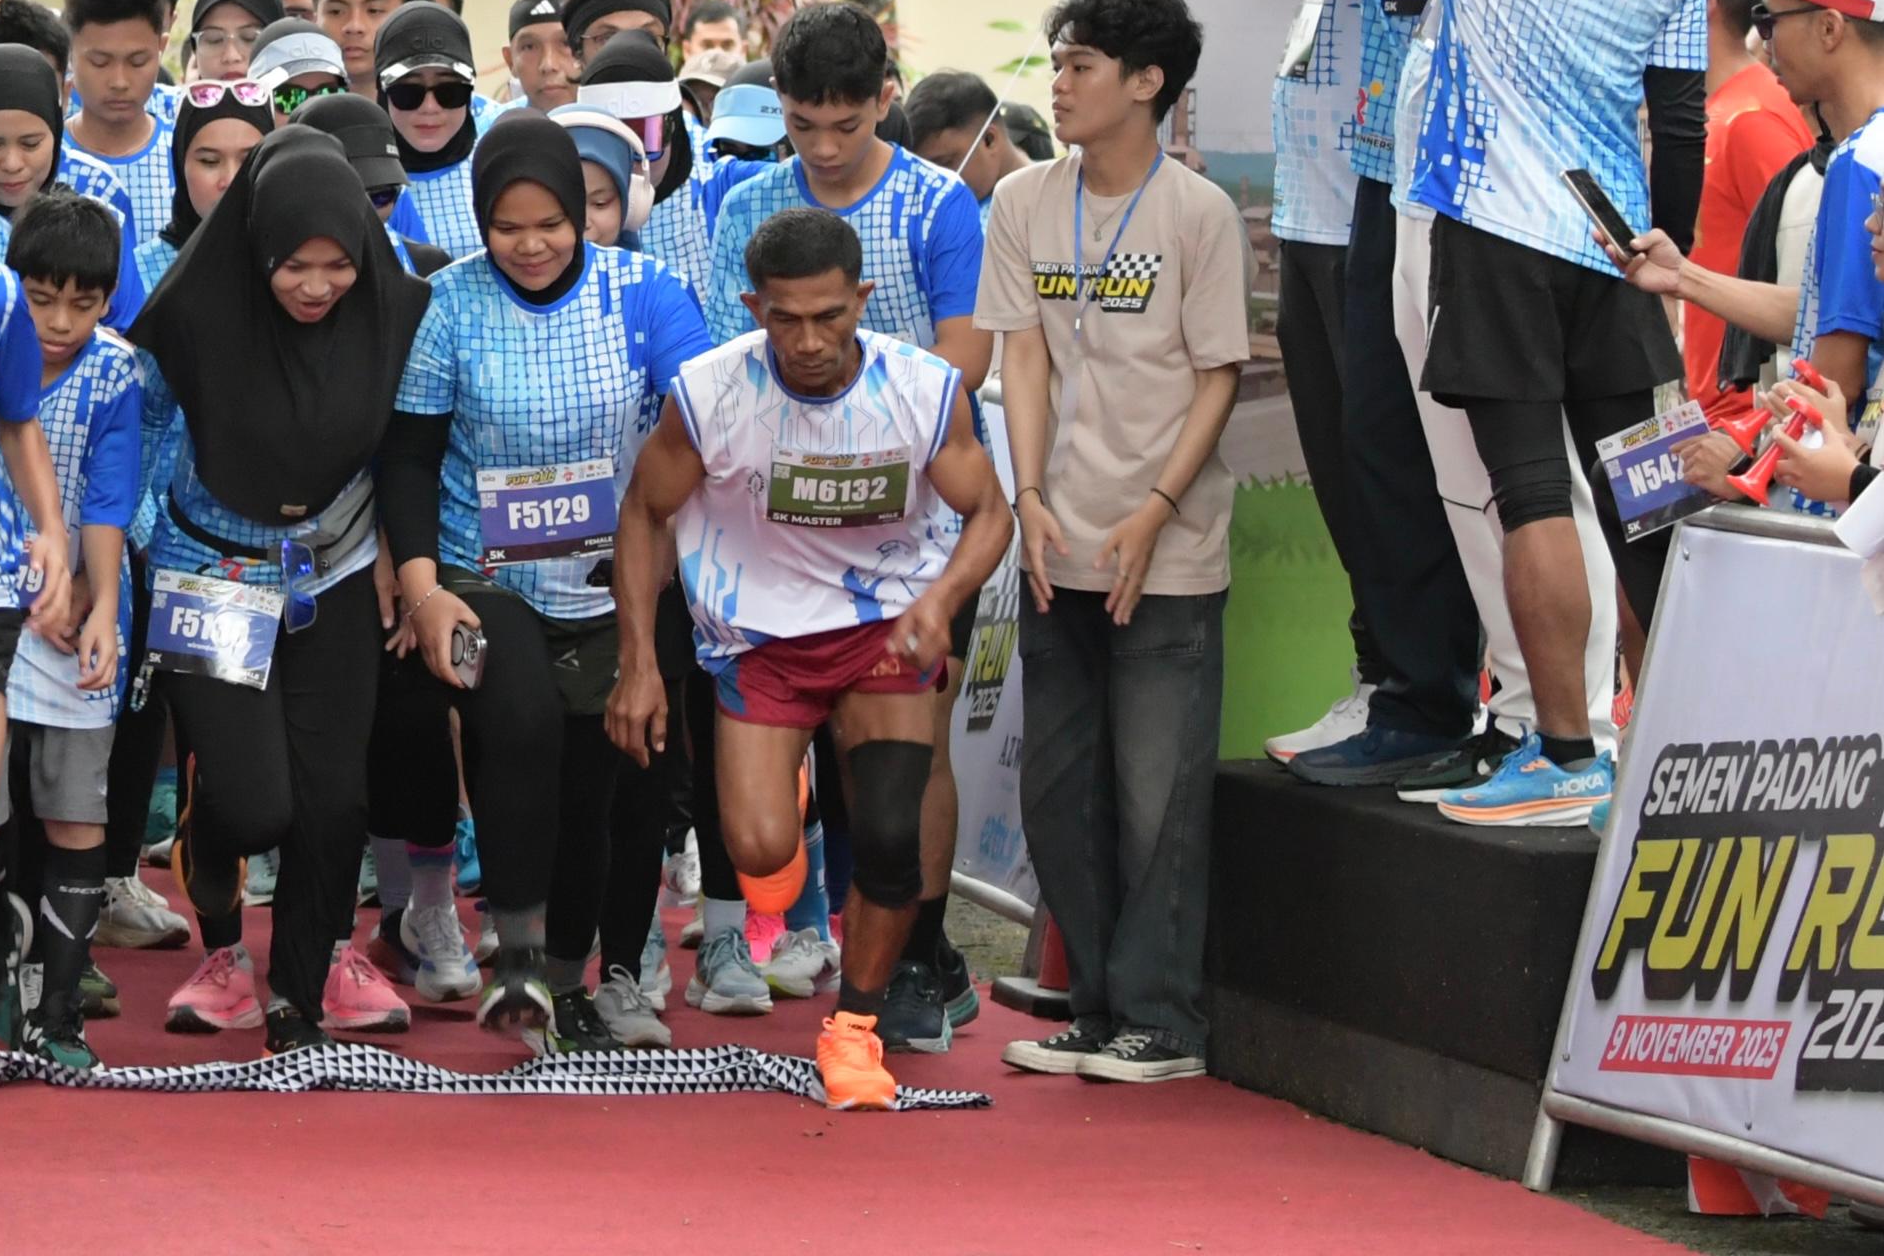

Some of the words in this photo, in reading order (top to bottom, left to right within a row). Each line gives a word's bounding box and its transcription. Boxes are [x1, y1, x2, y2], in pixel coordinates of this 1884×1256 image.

[1384, 1, 1397, 11] 5K
[288, 40, 324, 59] alo
[1100, 297, 1143, 309] 2025
[791, 475, 889, 503] M6132
[507, 494, 591, 530] F5129
[772, 511, 789, 522] 5K
[790, 514, 843, 526] MASTER
[1627, 520, 1641, 534] 5K
[489, 549, 506, 561] 5K
[148, 652, 162, 664] 5K
[1553, 771, 1605, 798] HOKA
[1645, 755, 1748, 817] SEMEN
[1743, 748, 1877, 812] PADANG
[1597, 835, 1797, 970] FUN
[1606, 1022, 1625, 1061] 9
[1625, 1023, 1734, 1065] NOVEMBER
[1731, 1026, 1783, 1068] 2025
